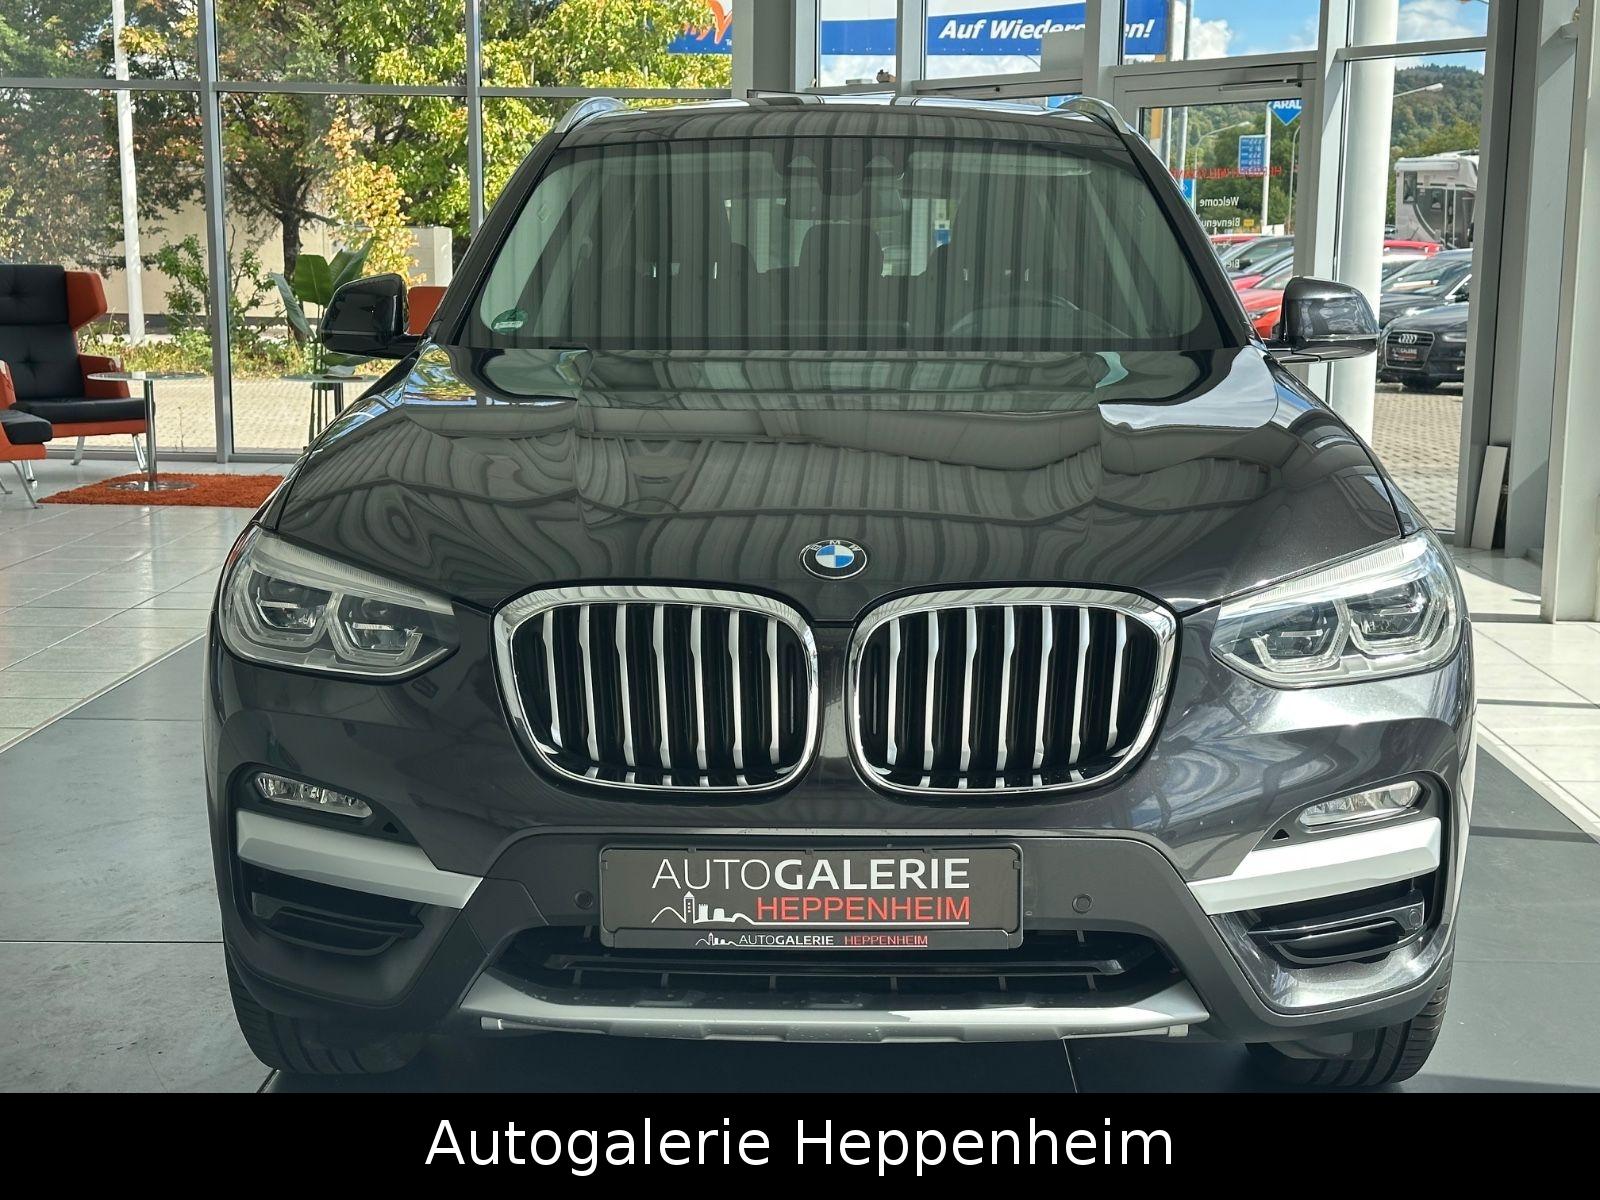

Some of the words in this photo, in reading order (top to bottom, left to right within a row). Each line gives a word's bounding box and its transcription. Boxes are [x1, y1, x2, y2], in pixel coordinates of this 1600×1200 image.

[938, 19, 986, 39] Auf
[1273, 100, 1302, 110] ARAL
[651, 857, 970, 891] AUTOGALERIE
[756, 895, 971, 921] HEPPENHEIM
[738, 934, 834, 946] AUTOGALERIE
[844, 934, 929, 946] HEPPENHEIM
